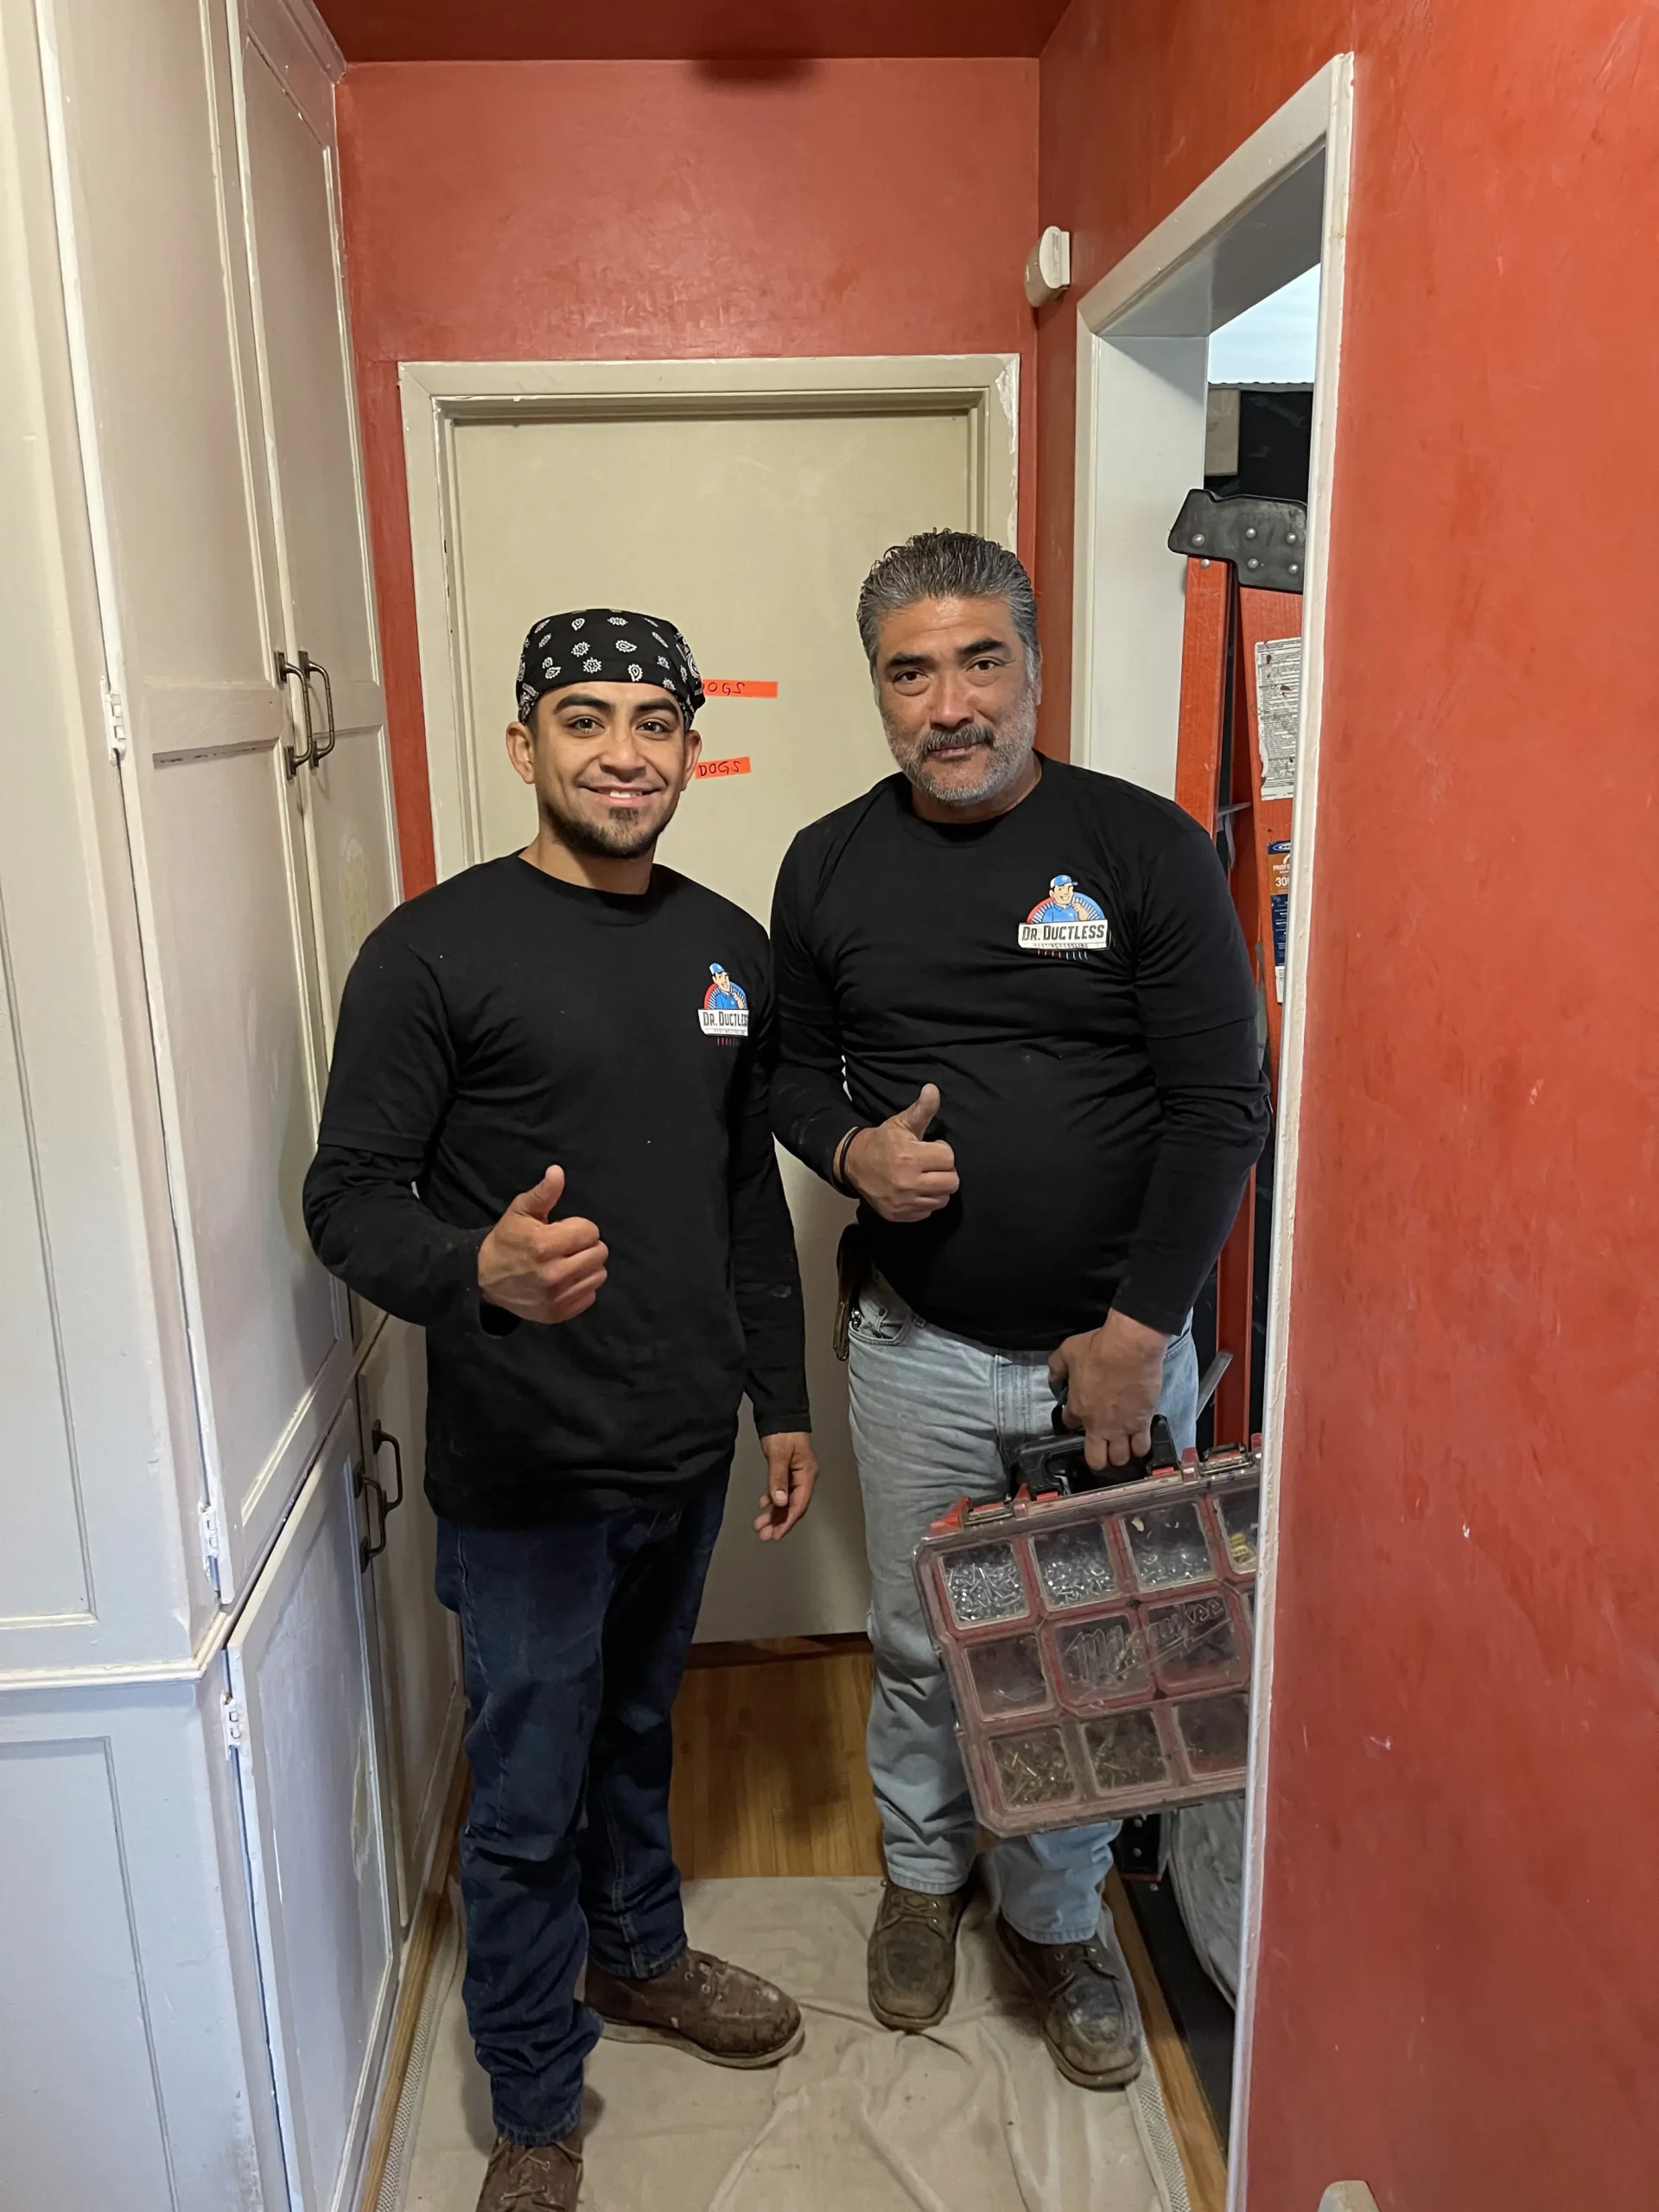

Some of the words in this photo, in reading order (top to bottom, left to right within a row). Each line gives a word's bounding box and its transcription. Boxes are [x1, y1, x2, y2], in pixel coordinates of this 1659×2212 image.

[702, 682, 745, 696] OGS
[698, 760, 741, 776] DOGS
[1021, 926, 1040, 941] DR.
[1043, 925, 1105, 940] DUCTLESS
[702, 1012, 718, 1027] DR.
